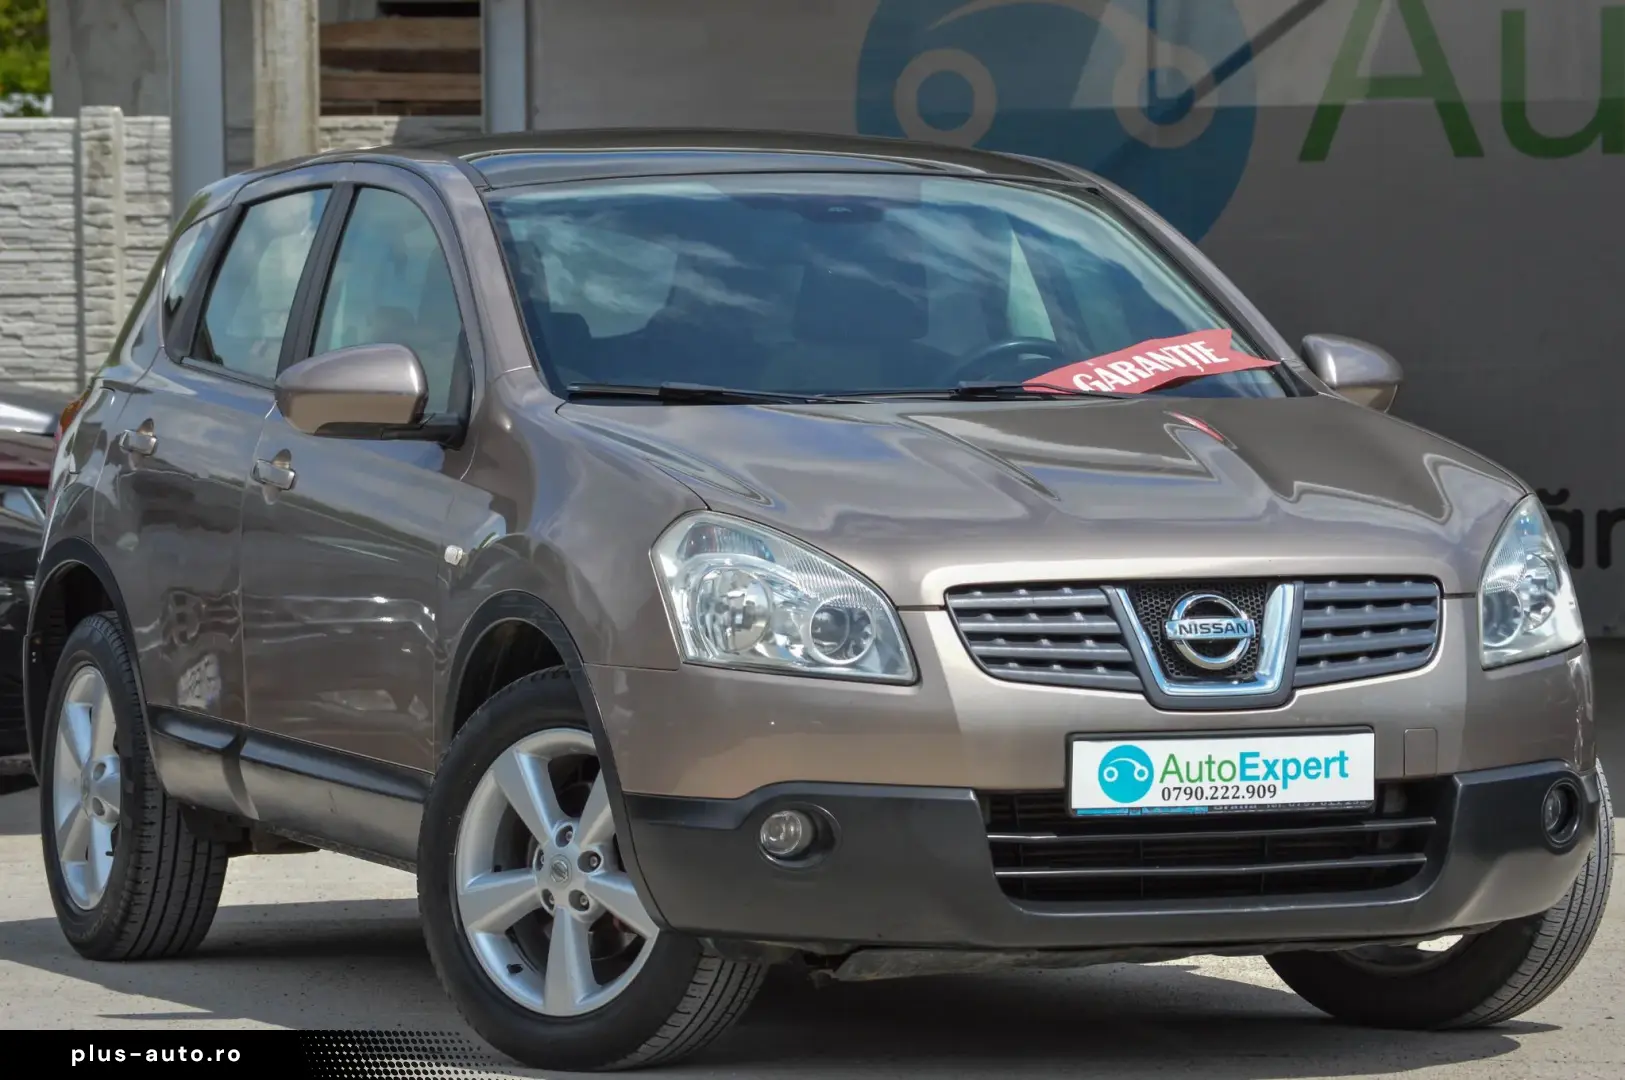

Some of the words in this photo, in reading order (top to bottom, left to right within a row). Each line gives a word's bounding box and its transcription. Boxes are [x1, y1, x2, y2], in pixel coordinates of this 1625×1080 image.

[1178, 622, 1248, 635] NISSAN
[1159, 750, 1349, 790] AutoExpert
[1161, 784, 1277, 801] 0790.222.909
